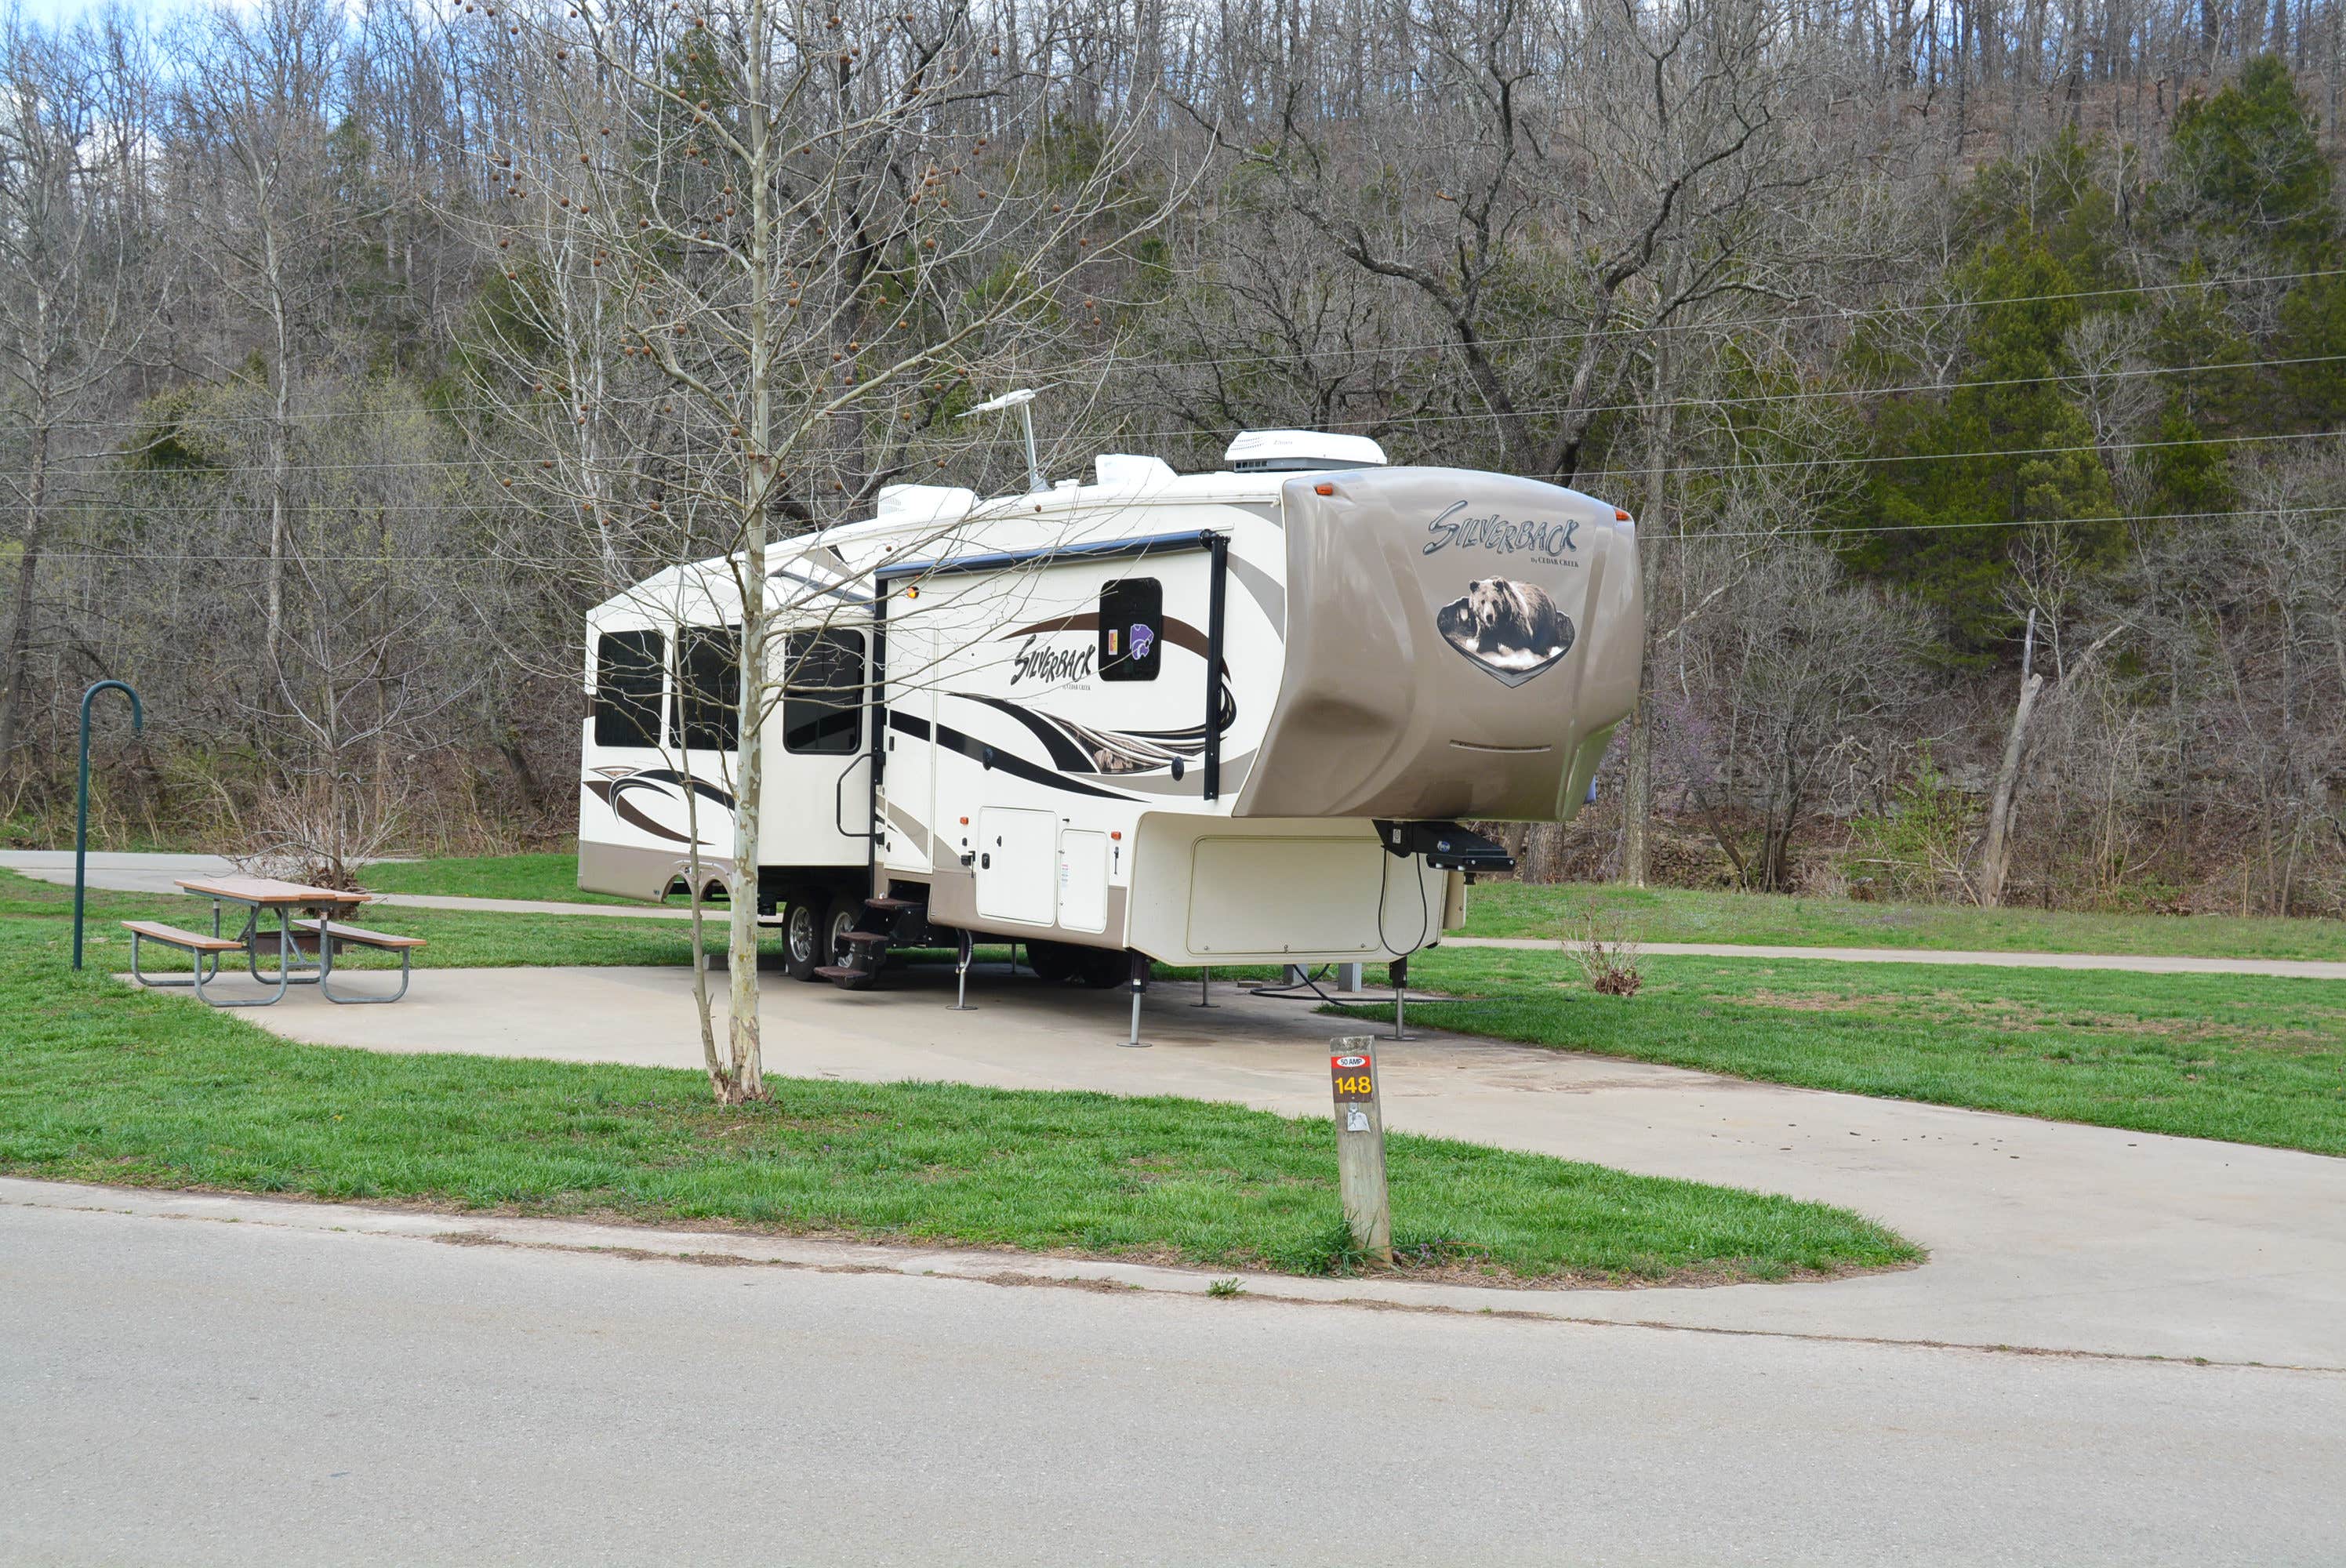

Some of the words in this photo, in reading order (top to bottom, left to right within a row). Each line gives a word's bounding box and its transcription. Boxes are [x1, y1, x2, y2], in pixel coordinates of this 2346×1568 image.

[1422, 499, 1579, 556] SILVERBACK
[1011, 633, 1095, 685] SILVERBACK
[1335, 1076, 1371, 1094] 148
